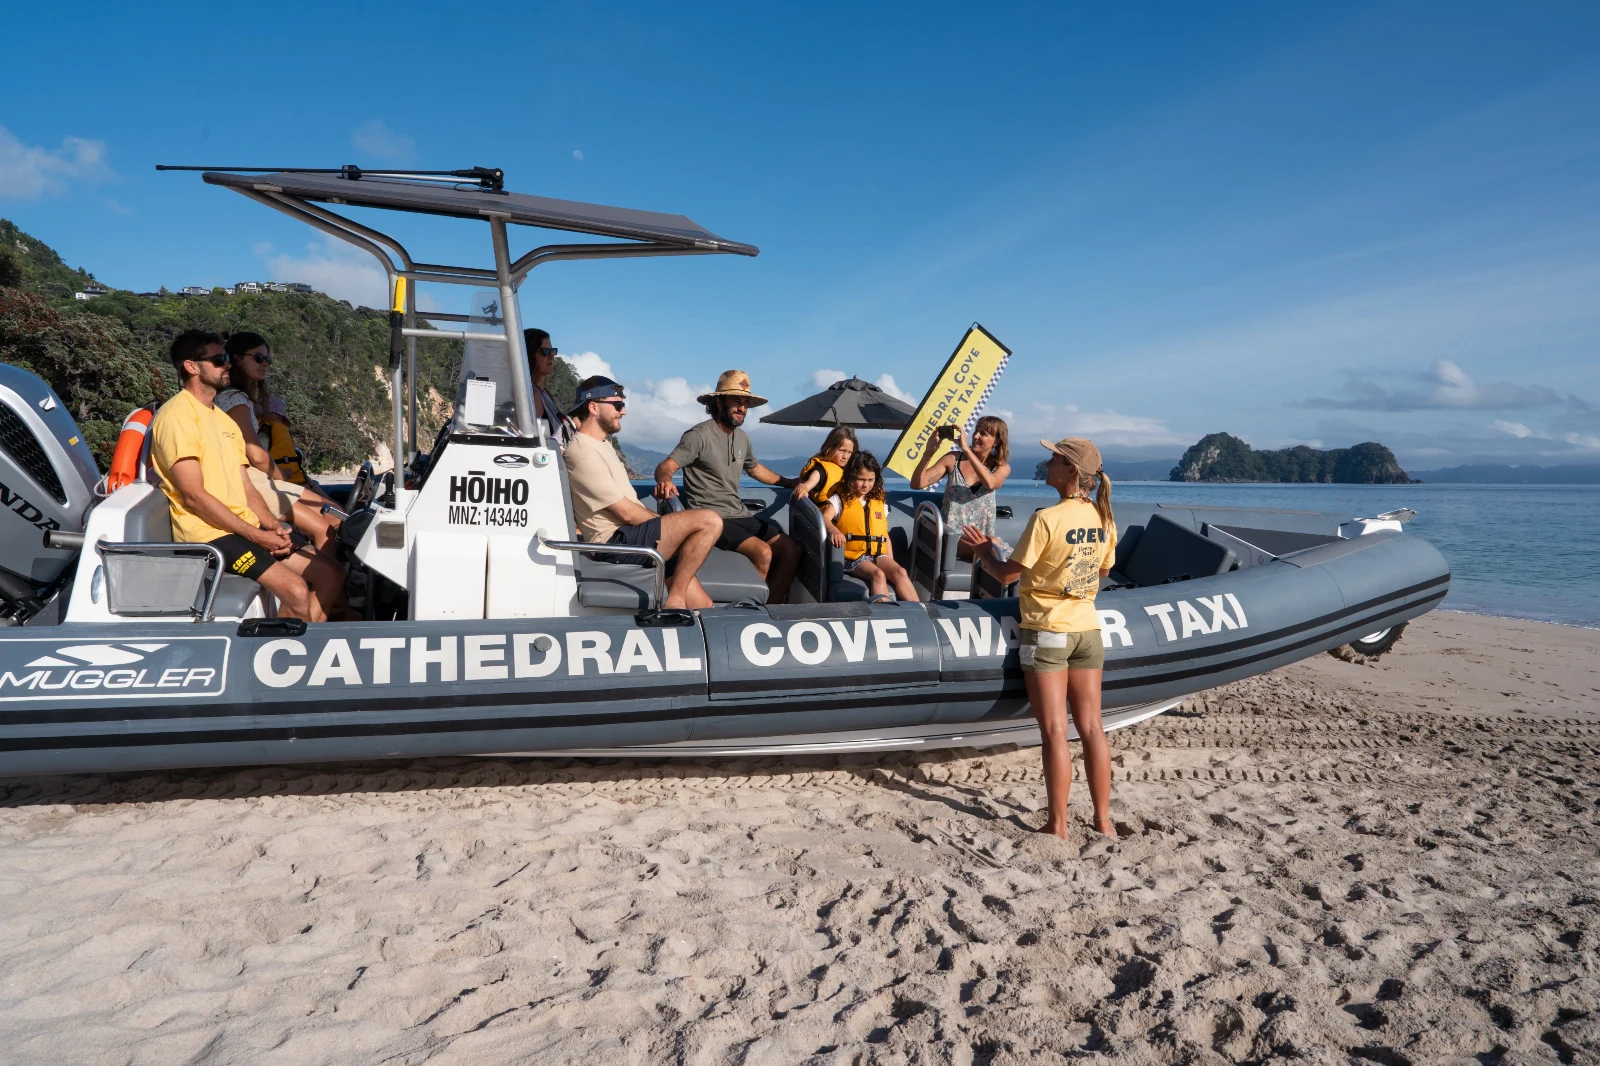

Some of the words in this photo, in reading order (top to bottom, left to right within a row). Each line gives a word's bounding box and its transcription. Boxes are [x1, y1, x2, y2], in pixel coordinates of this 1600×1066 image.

[906, 388, 958, 460] CATHEDRAL
[954, 347, 980, 384] COVE
[958, 374, 981, 404] TAXI
[449, 470, 530, 505] HŌIHO
[448, 505, 481, 526] MNZ:
[484, 507, 528, 527] 143449
[253, 628, 702, 688] CATHEDRAL
[740, 618, 914, 667] COVE
[937, 609, 1134, 658] WAR
[1143, 593, 1248, 642] TAXI
[0, 667, 216, 690] MUGGLER
